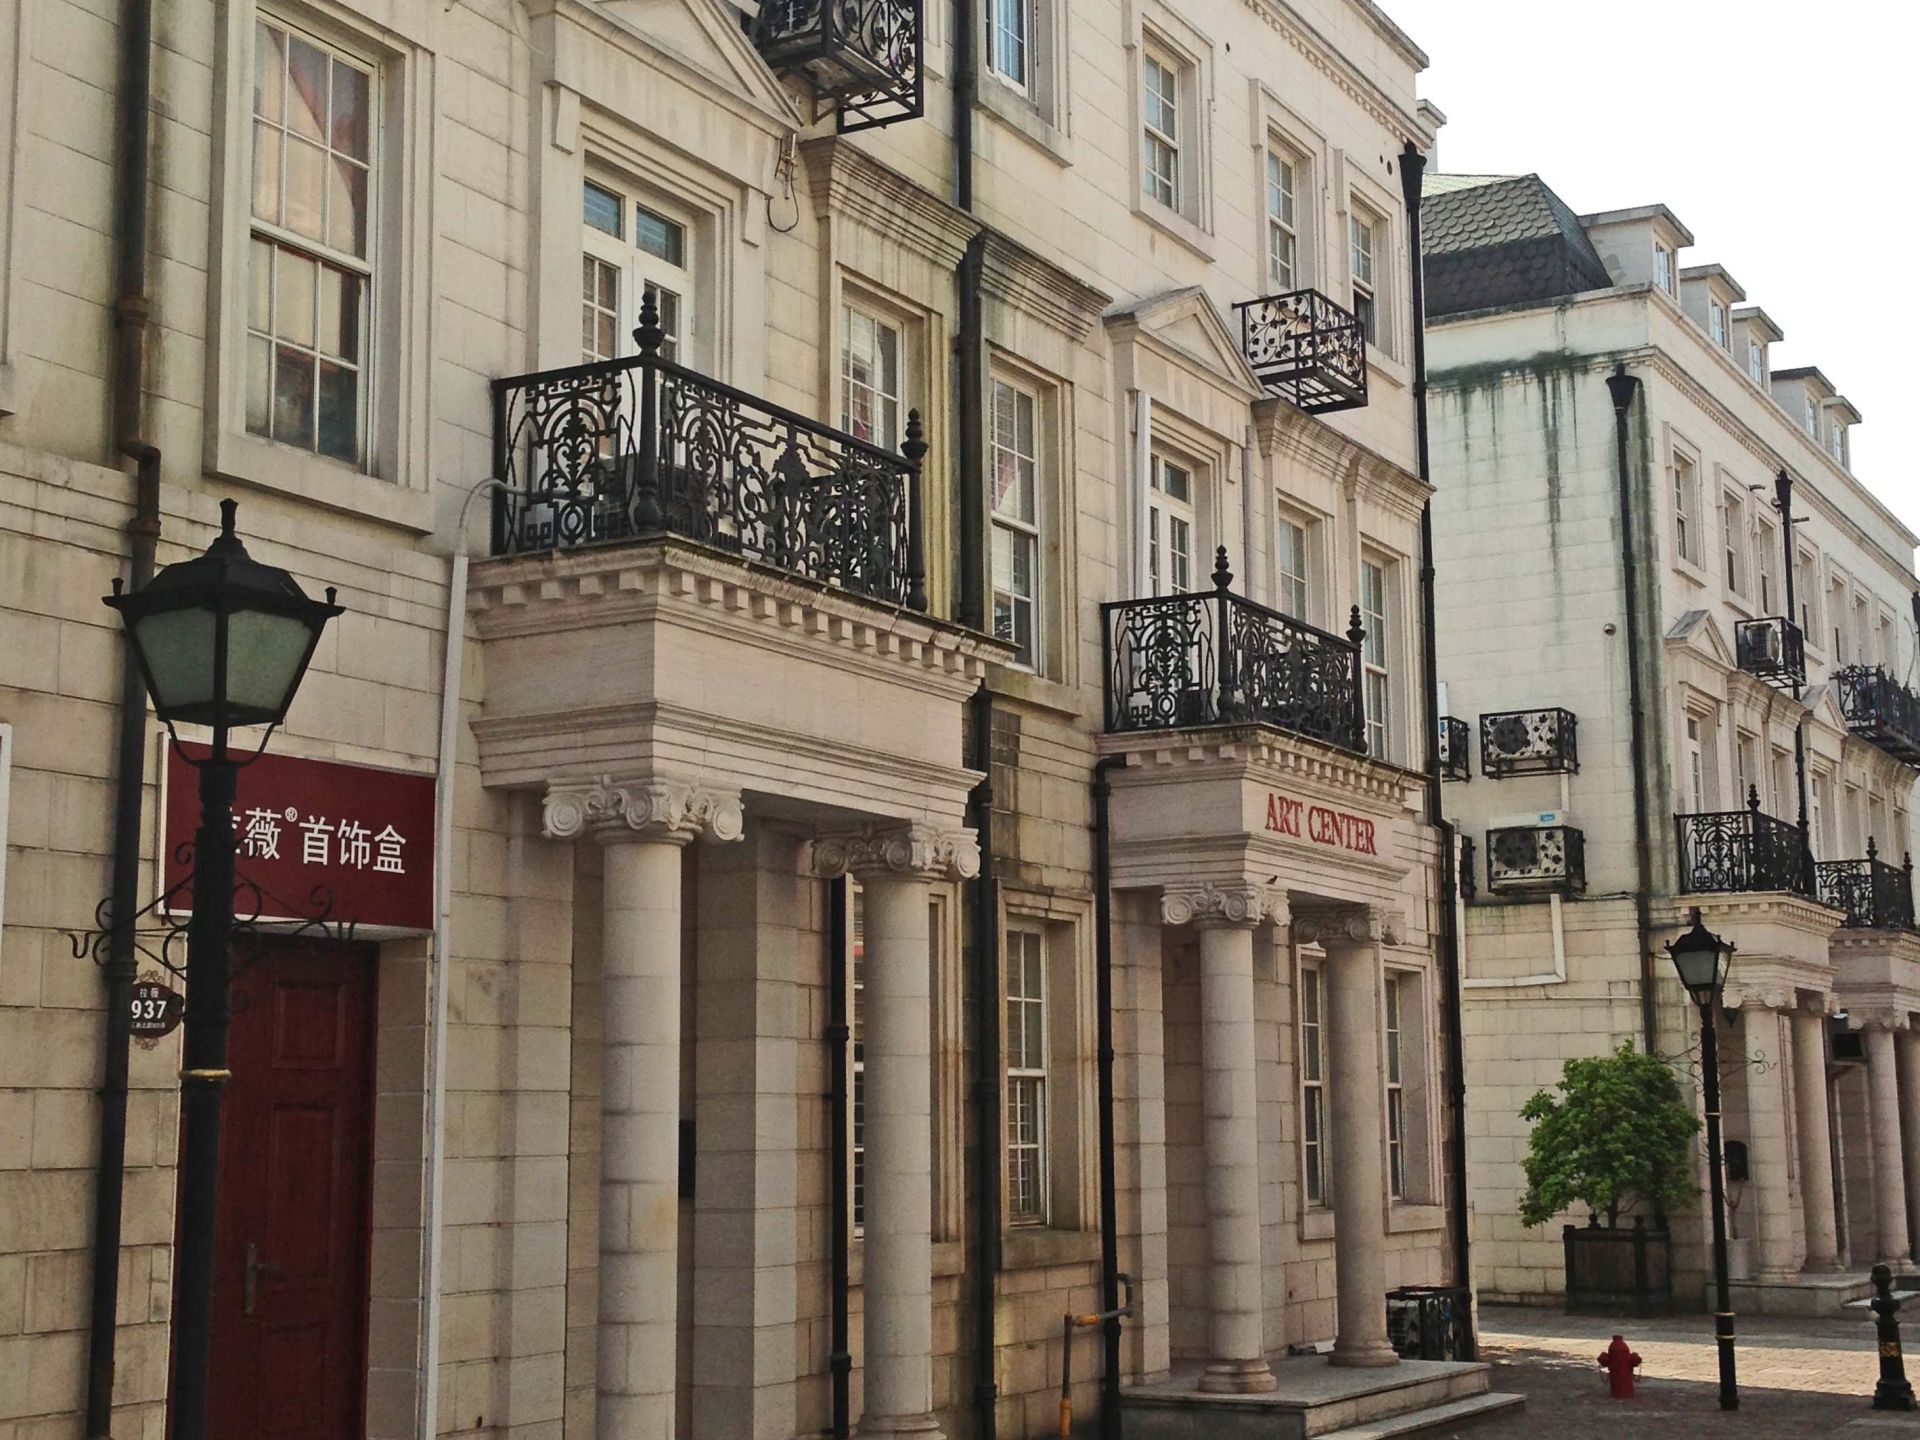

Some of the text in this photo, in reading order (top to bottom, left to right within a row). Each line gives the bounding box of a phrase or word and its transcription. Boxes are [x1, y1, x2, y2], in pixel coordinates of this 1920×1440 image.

[1265, 793, 1377, 855] ART CENTER
[131, 1000, 167, 1019] 937
